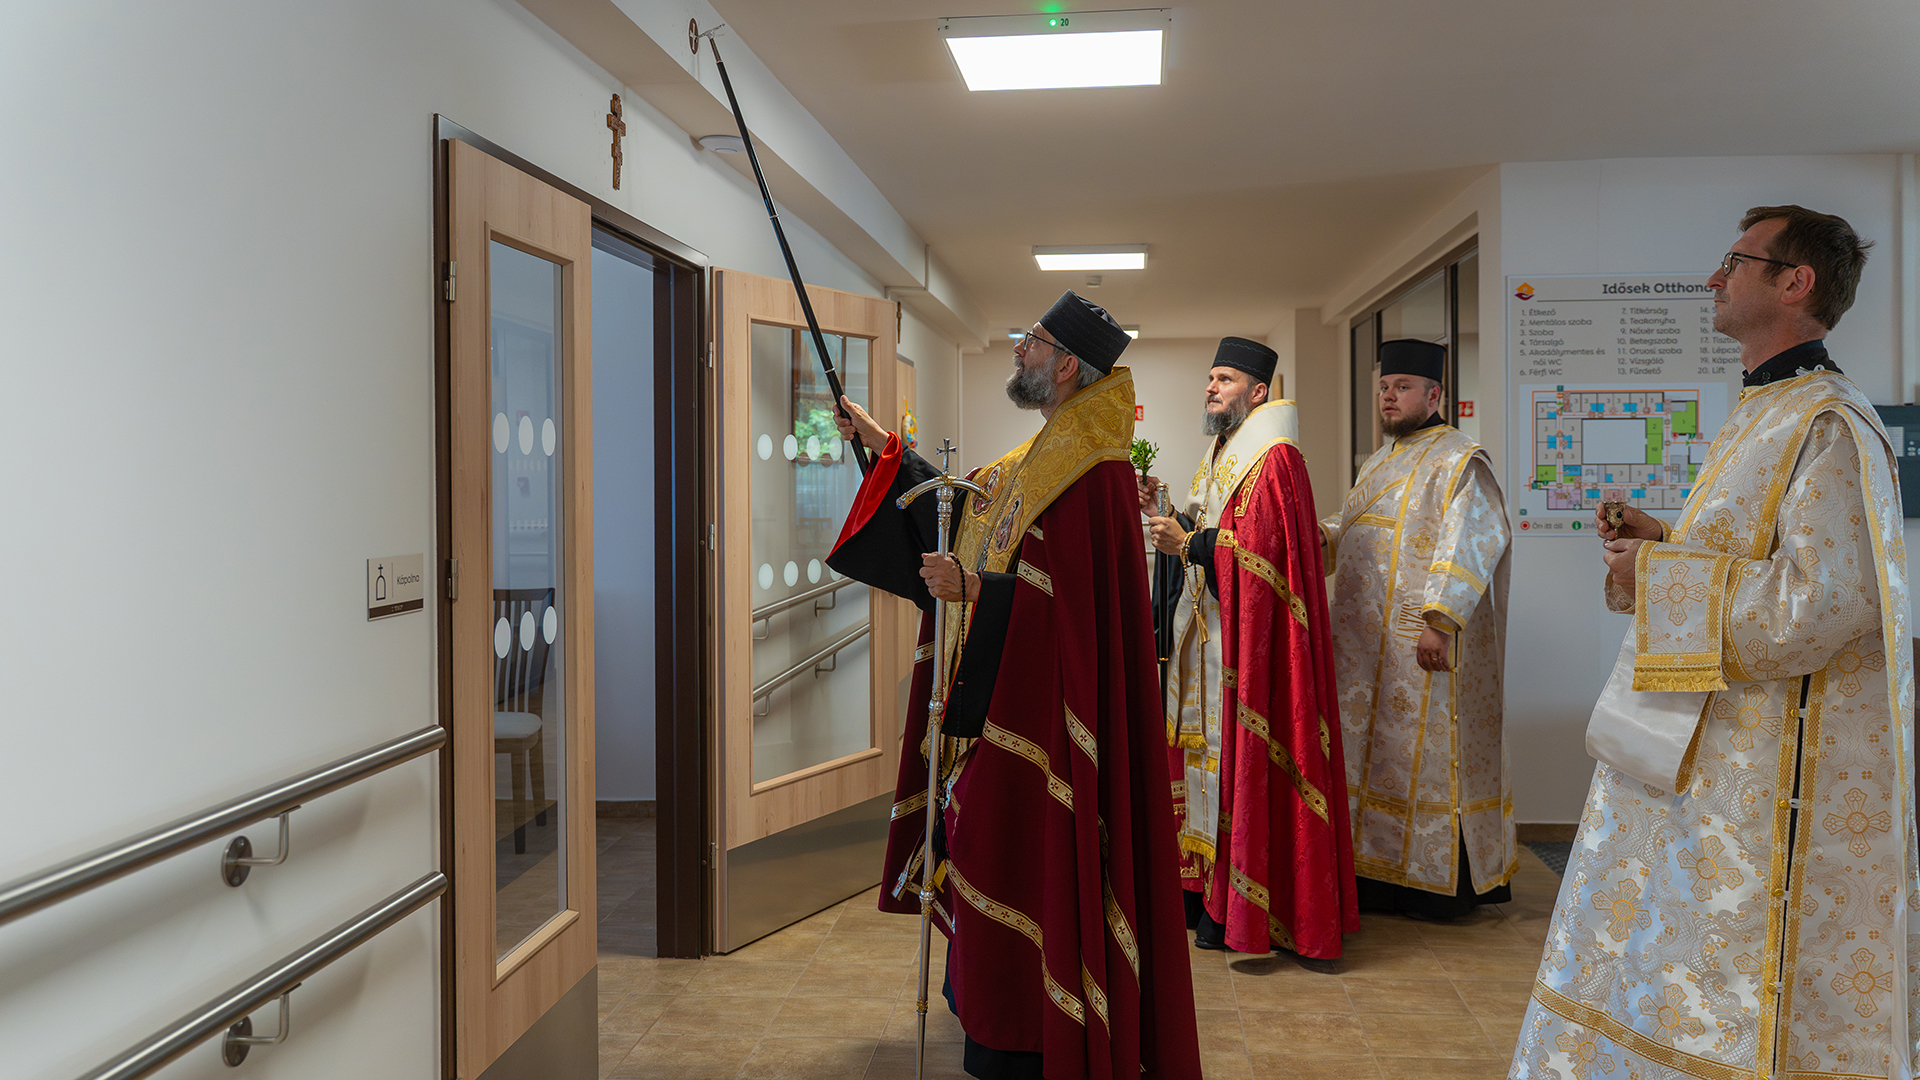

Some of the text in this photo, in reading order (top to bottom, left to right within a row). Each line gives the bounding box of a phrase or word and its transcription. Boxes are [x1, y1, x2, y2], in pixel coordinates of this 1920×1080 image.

[1060, 18, 1069, 26] 20
[1602, 282, 1650, 294] Idősek
[1529, 308, 1556, 316] Étkező
[1629, 307, 1668, 316] Titkárság
[1629, 317, 1676, 326] Teakonyha
[1529, 338, 1564, 347] Társalgó
[1629, 338, 1678, 346] Betegszoba
[1529, 349, 1594, 357] Akadálymentes
[1596, 347, 1605, 355] és
[1629, 357, 1664, 366] Vizsgáló
[1711, 356, 1741, 364] Kápoln
[1529, 368, 1547, 377] Férfi
[1548, 368, 1562, 376] WC
[1711, 366, 1725, 374] Lift
